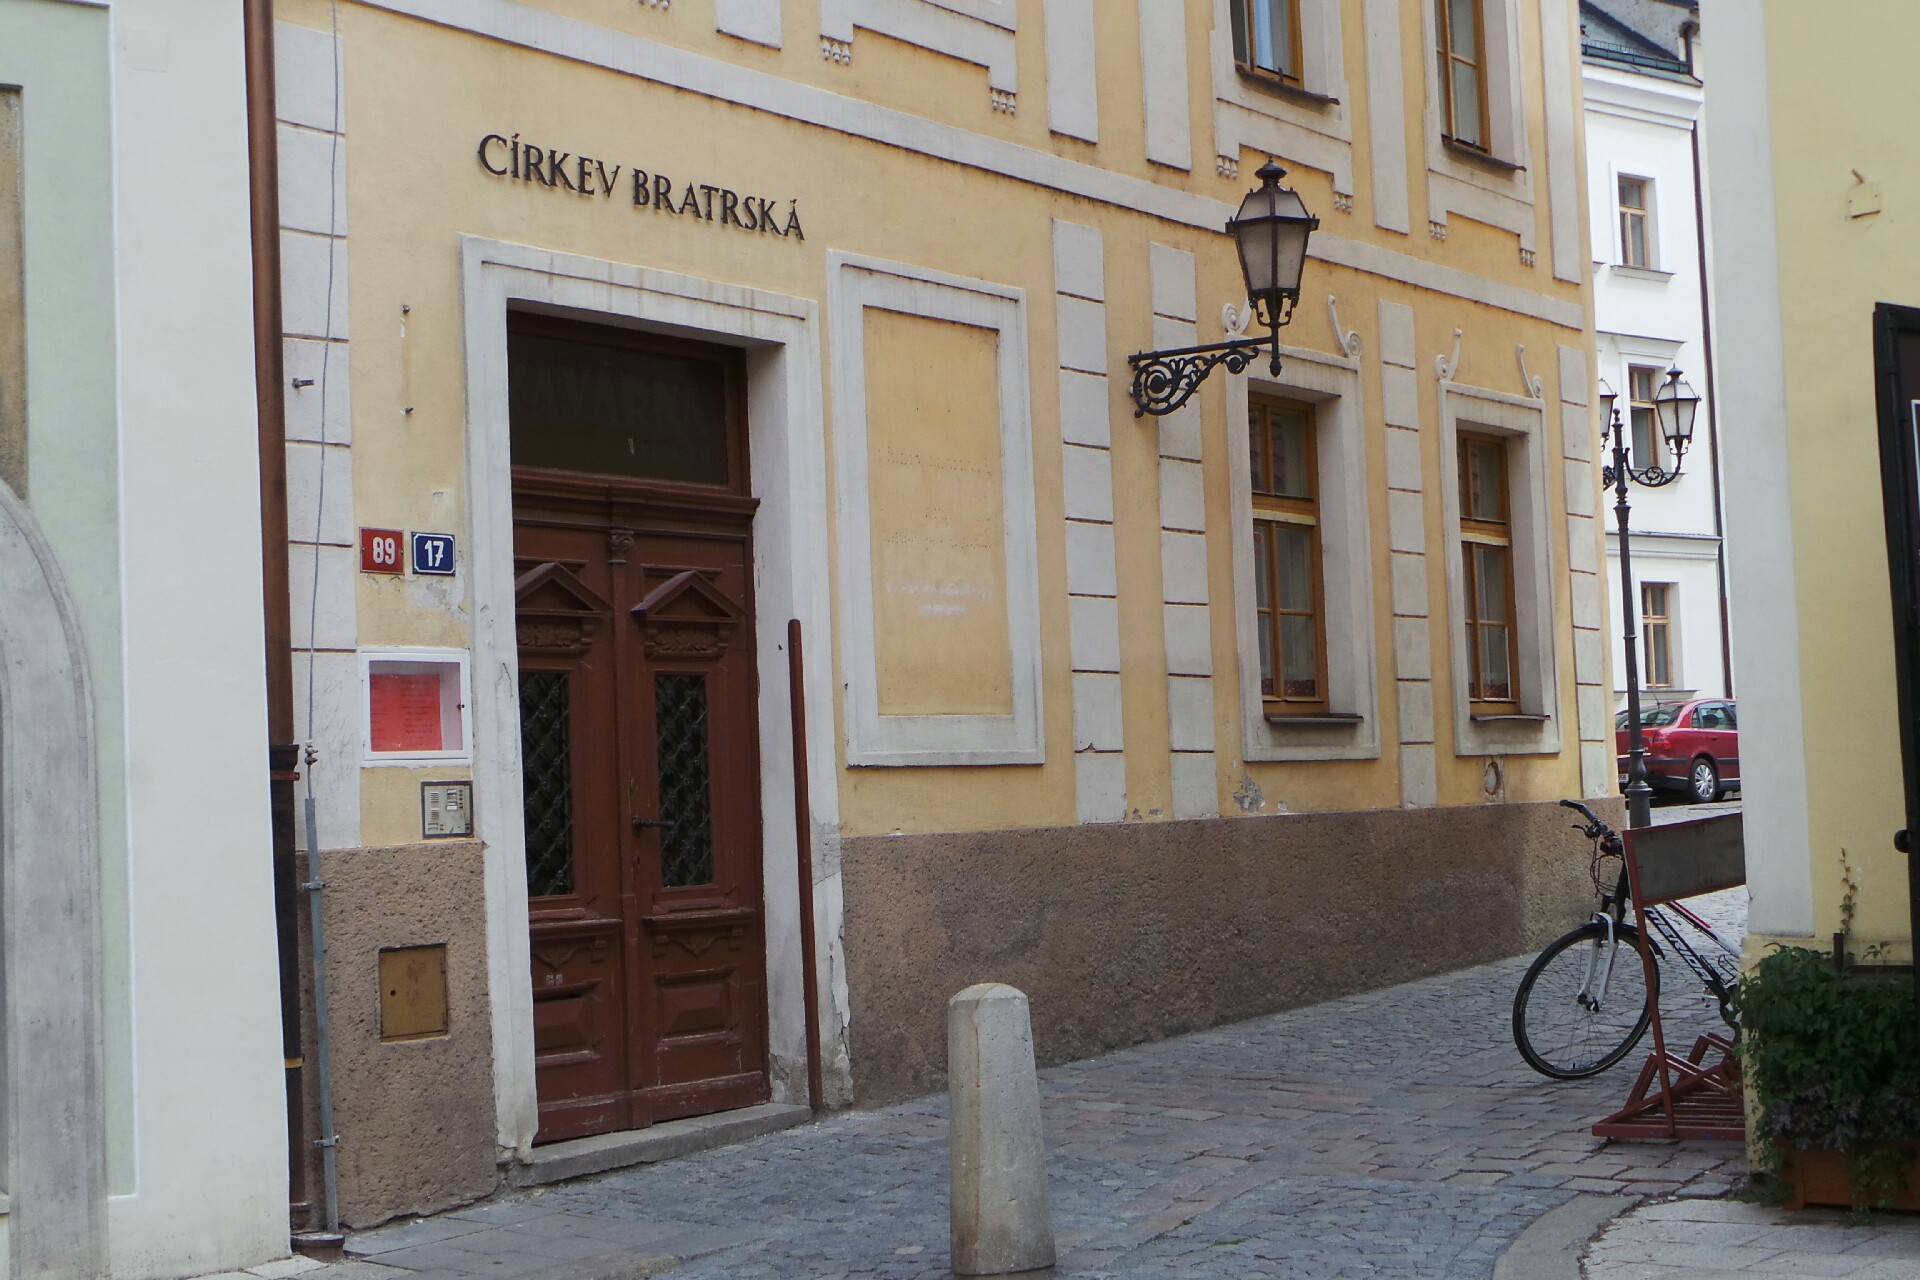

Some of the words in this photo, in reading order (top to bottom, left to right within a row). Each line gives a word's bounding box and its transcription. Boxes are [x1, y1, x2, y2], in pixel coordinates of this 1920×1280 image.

[477, 132, 621, 199] CÍRKEV
[632, 167, 806, 242] BRATRSKÁ
[372, 536, 396, 565] 89
[424, 539, 445, 567] 17
[1643, 906, 1714, 981] MERIDA
